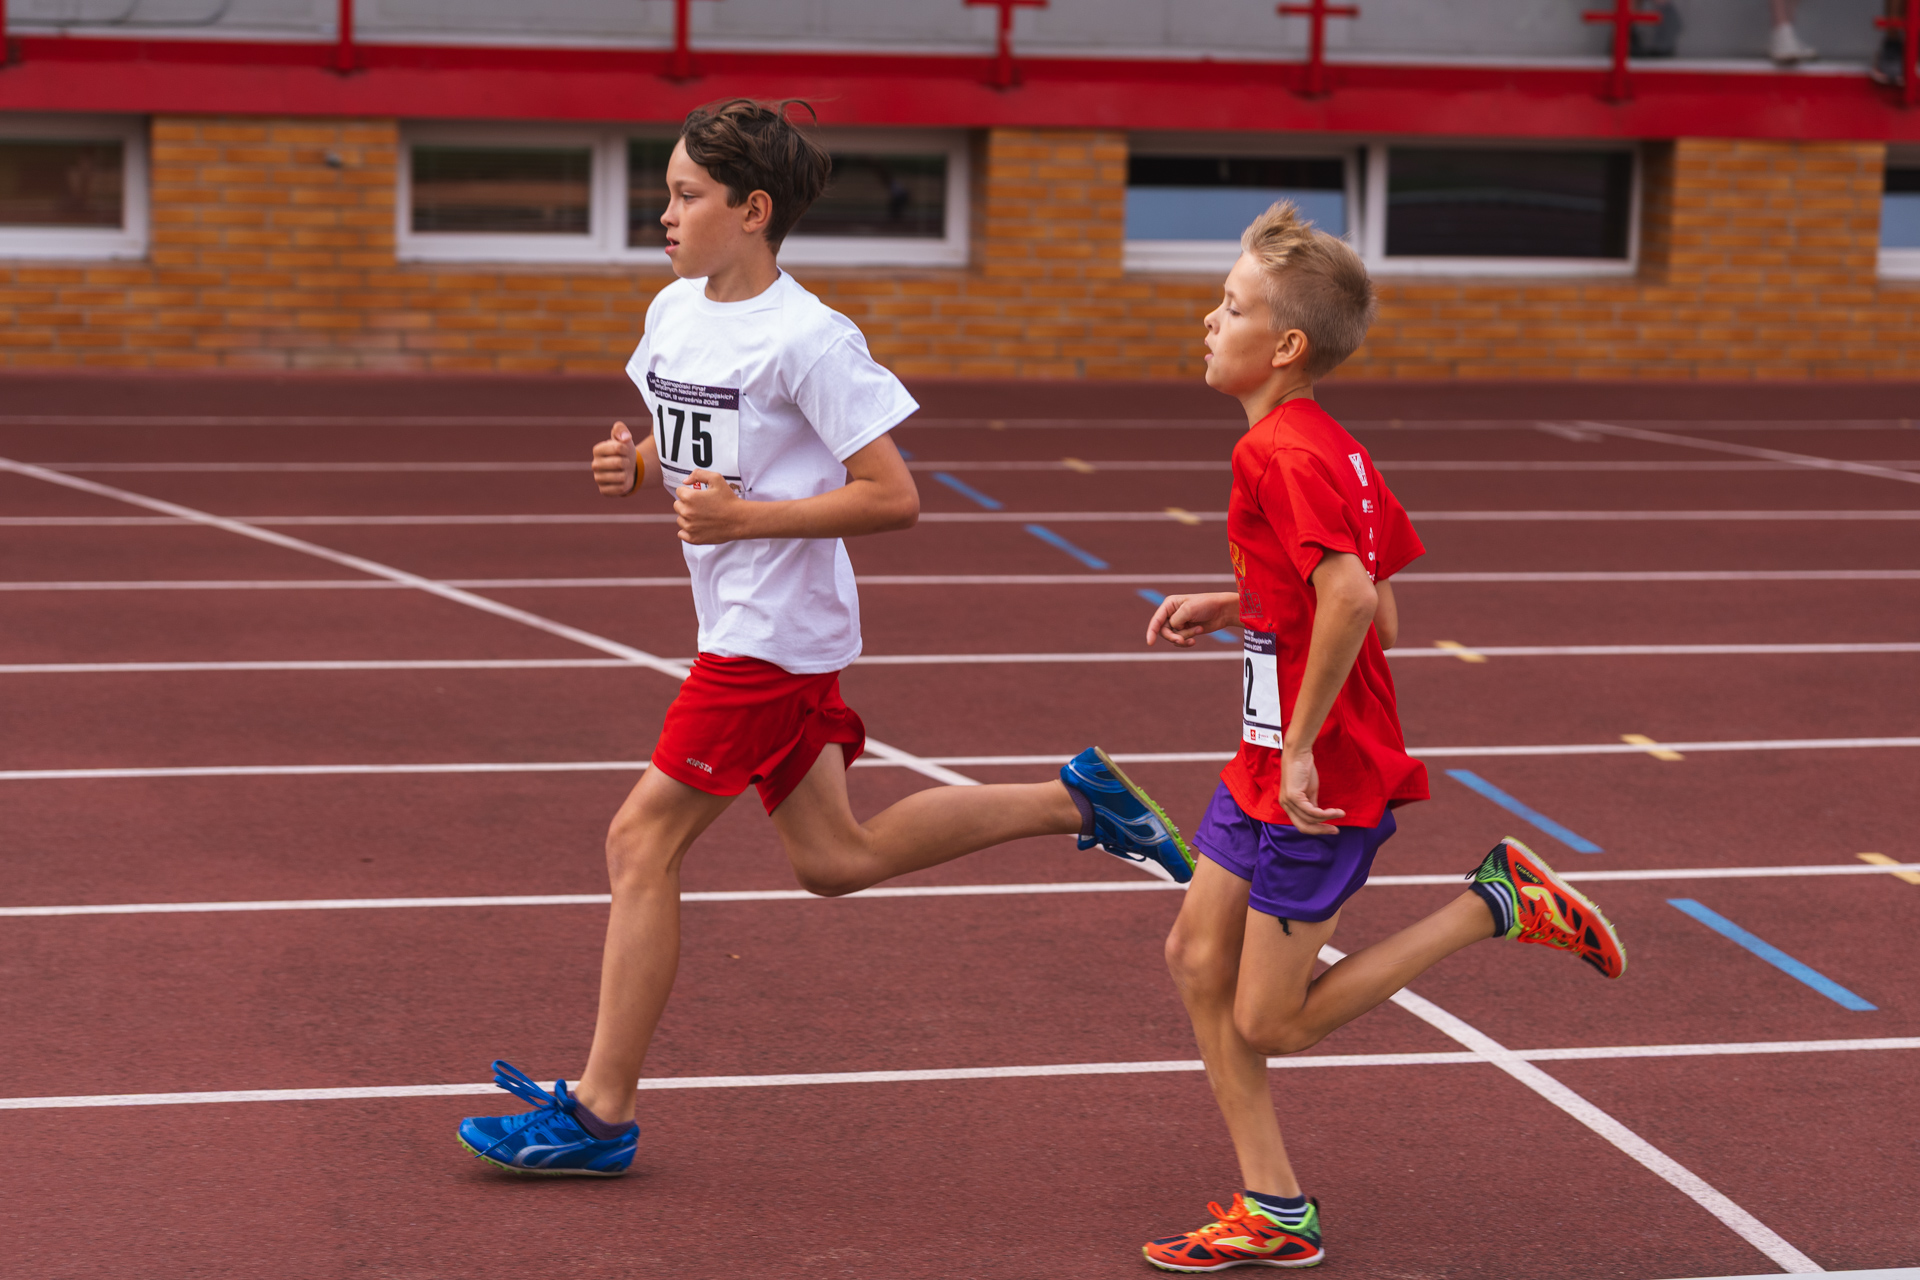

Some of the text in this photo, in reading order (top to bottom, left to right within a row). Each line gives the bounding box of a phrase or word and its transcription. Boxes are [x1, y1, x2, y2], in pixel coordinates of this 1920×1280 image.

[699, 391, 734, 401] Olimpijskich
[657, 404, 713, 468] 175
[1245, 657, 1257, 717] 2
[686, 757, 712, 775] KIPSTA
